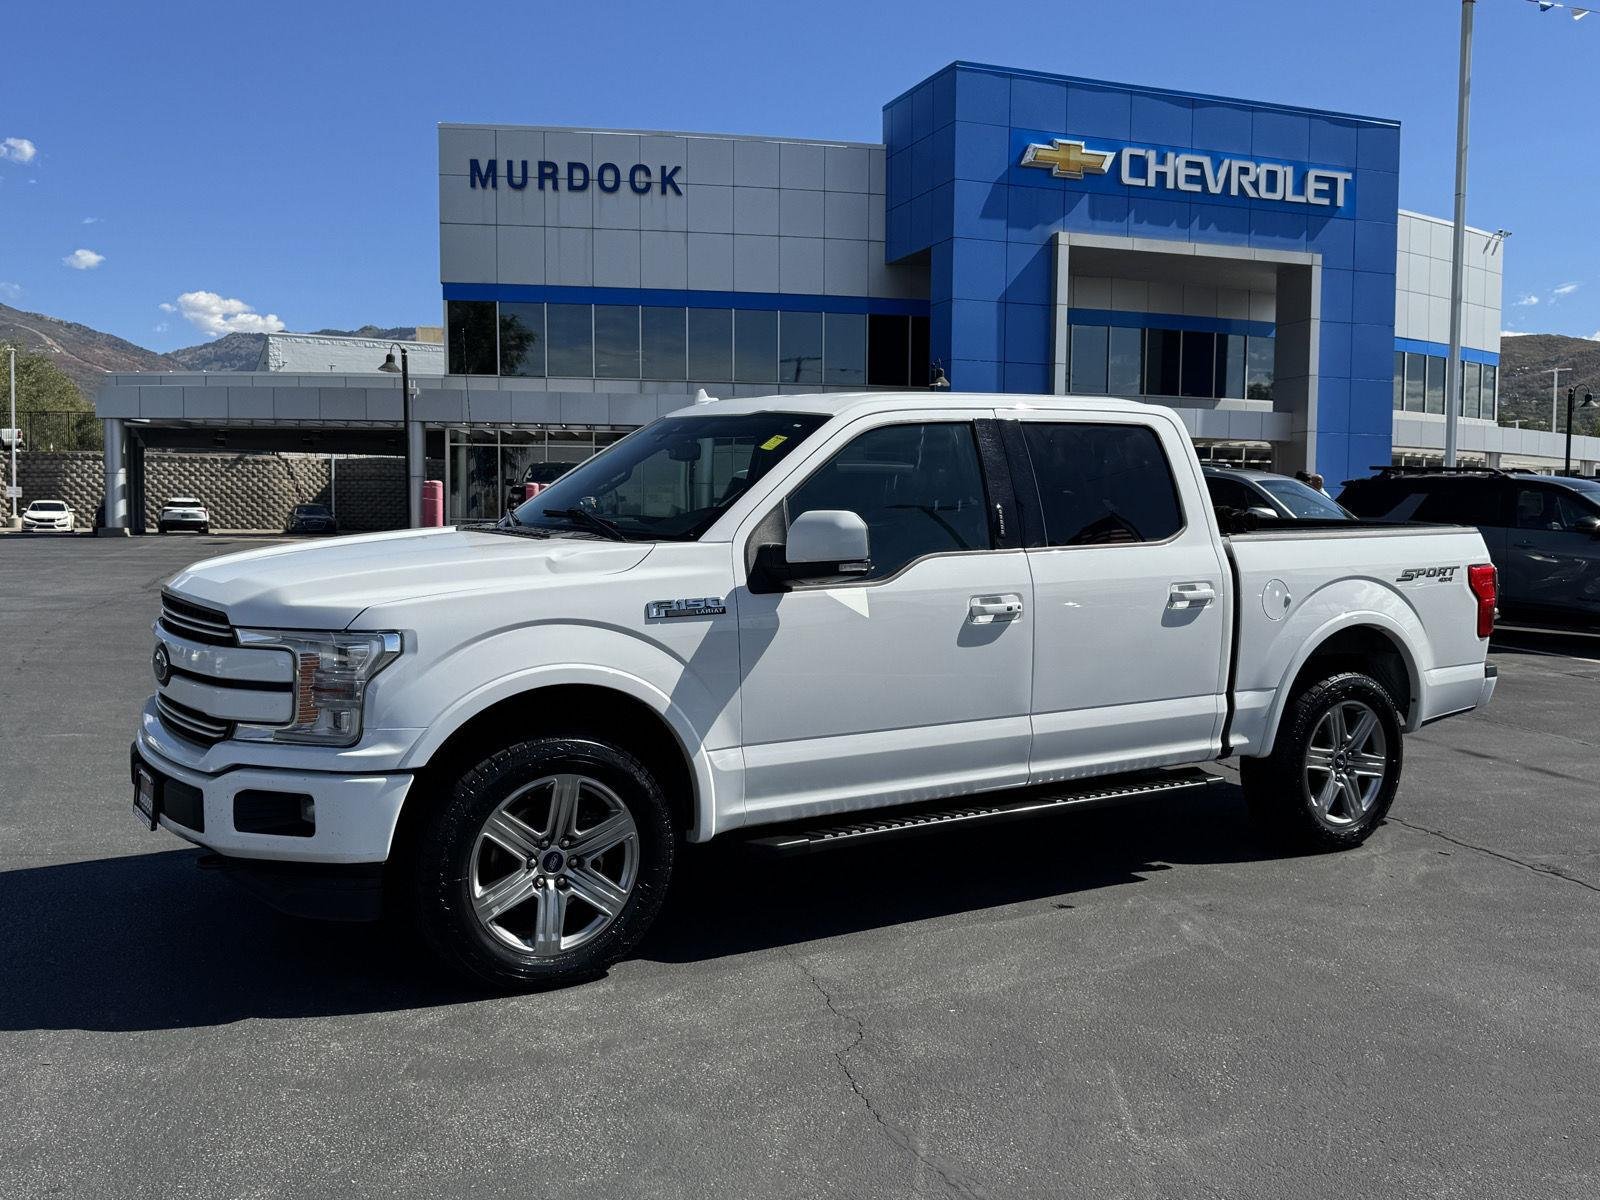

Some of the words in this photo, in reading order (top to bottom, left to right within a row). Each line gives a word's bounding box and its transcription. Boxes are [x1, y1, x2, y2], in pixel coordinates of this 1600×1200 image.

[469, 158, 683, 197] MURDOCK
[1120, 147, 1352, 207] CHEVROLET
[1396, 566, 1460, 582] SPORT
